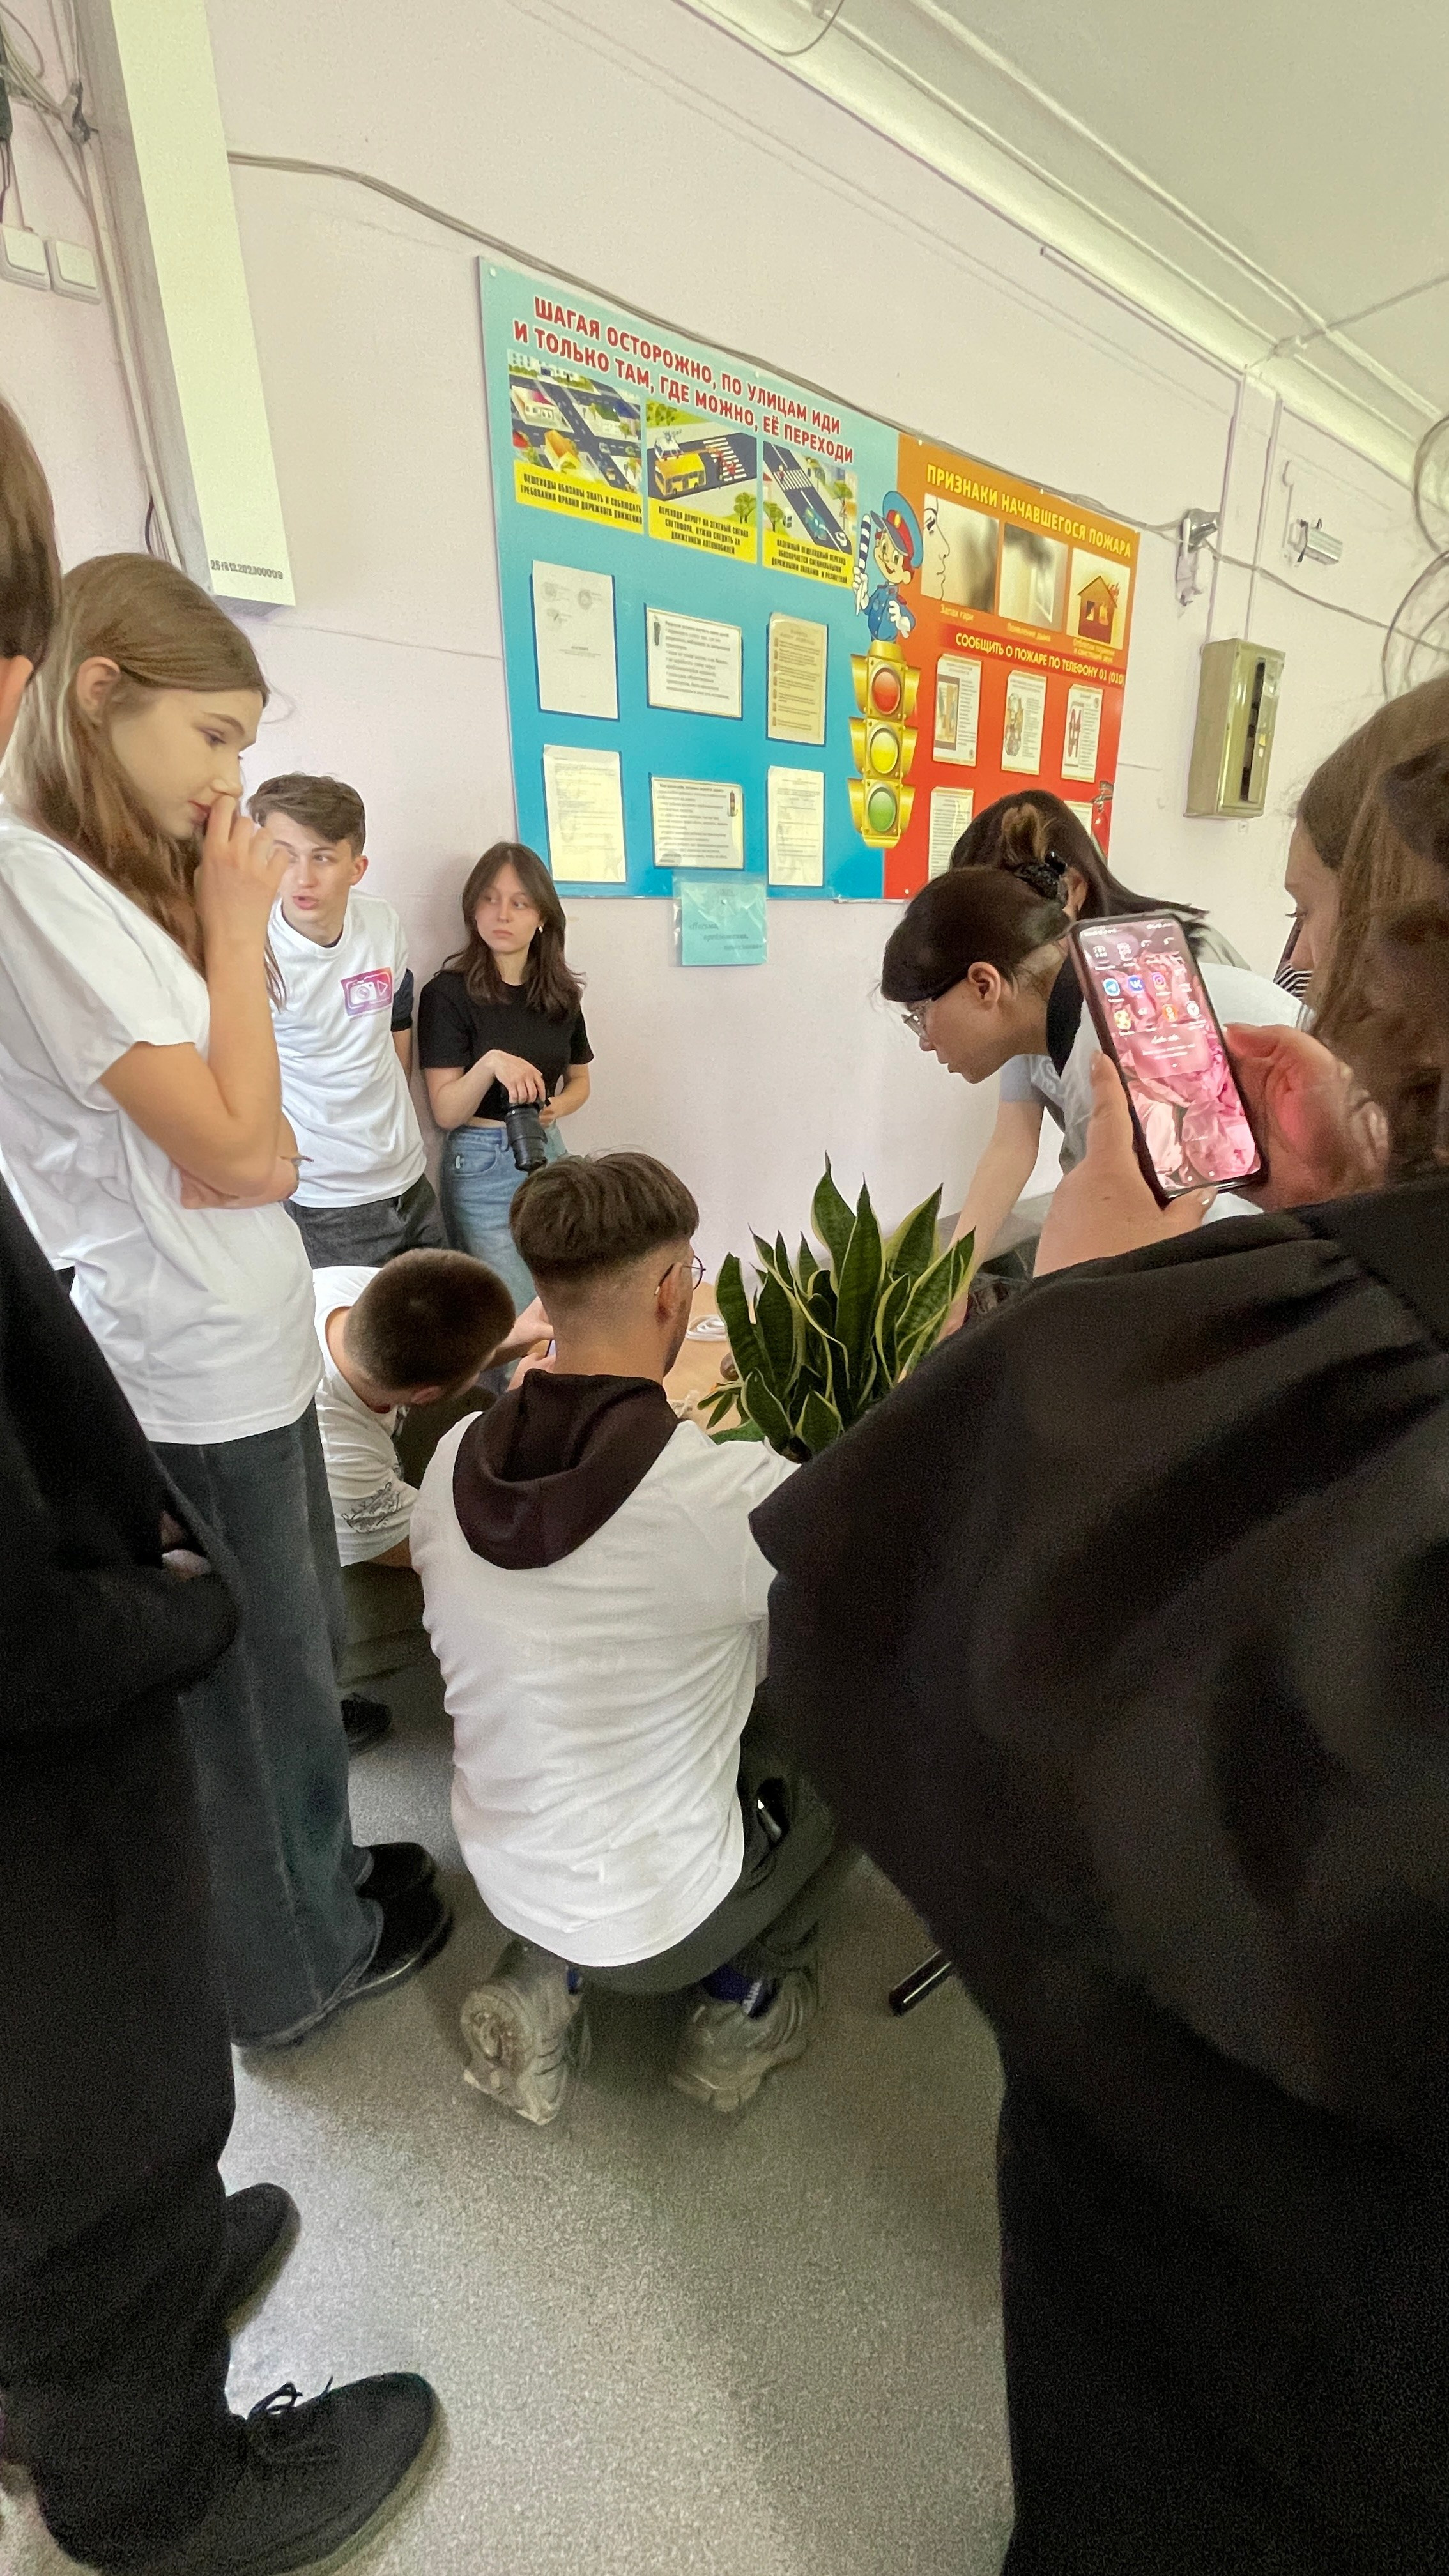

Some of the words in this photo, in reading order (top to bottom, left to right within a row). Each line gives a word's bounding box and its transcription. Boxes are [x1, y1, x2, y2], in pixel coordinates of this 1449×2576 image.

[514, 320, 528, 344] И
[534, 328, 610, 372] ТОЛЬКО
[615, 358, 654, 394] ТАМ,
[661, 376, 689, 404] ГДЕ
[695, 390, 758, 432] МОЖНО,
[763, 415, 779, 436] ЕЁ
[785, 424, 853, 464] ПЕРЕХОДИ
[534, 296, 601, 341] ШАГАЯ
[607, 326, 716, 390] ОСТОРОЖНО,
[722, 373, 742, 396] ПО
[747, 383, 807, 422] УЛИЦАМ
[812, 410, 840, 434] ИДИ
[927, 464, 998, 508] ПРИЗНАКИ
[1001, 493, 1086, 541] НАЧАВШЕГОСЯ
[1089, 528, 1131, 558] ПОЖАРА
[955, 632, 1004, 656] СООБЩИТЬ
[1006, 645, 1013, 657] О
[1015, 647, 1048, 668] ПОЖАРЕ
[1049, 656, 1061, 670] ПО
[1062, 658, 1098, 679] ТЕЛЕФОНУ
[1098, 668, 1108, 682] 01
